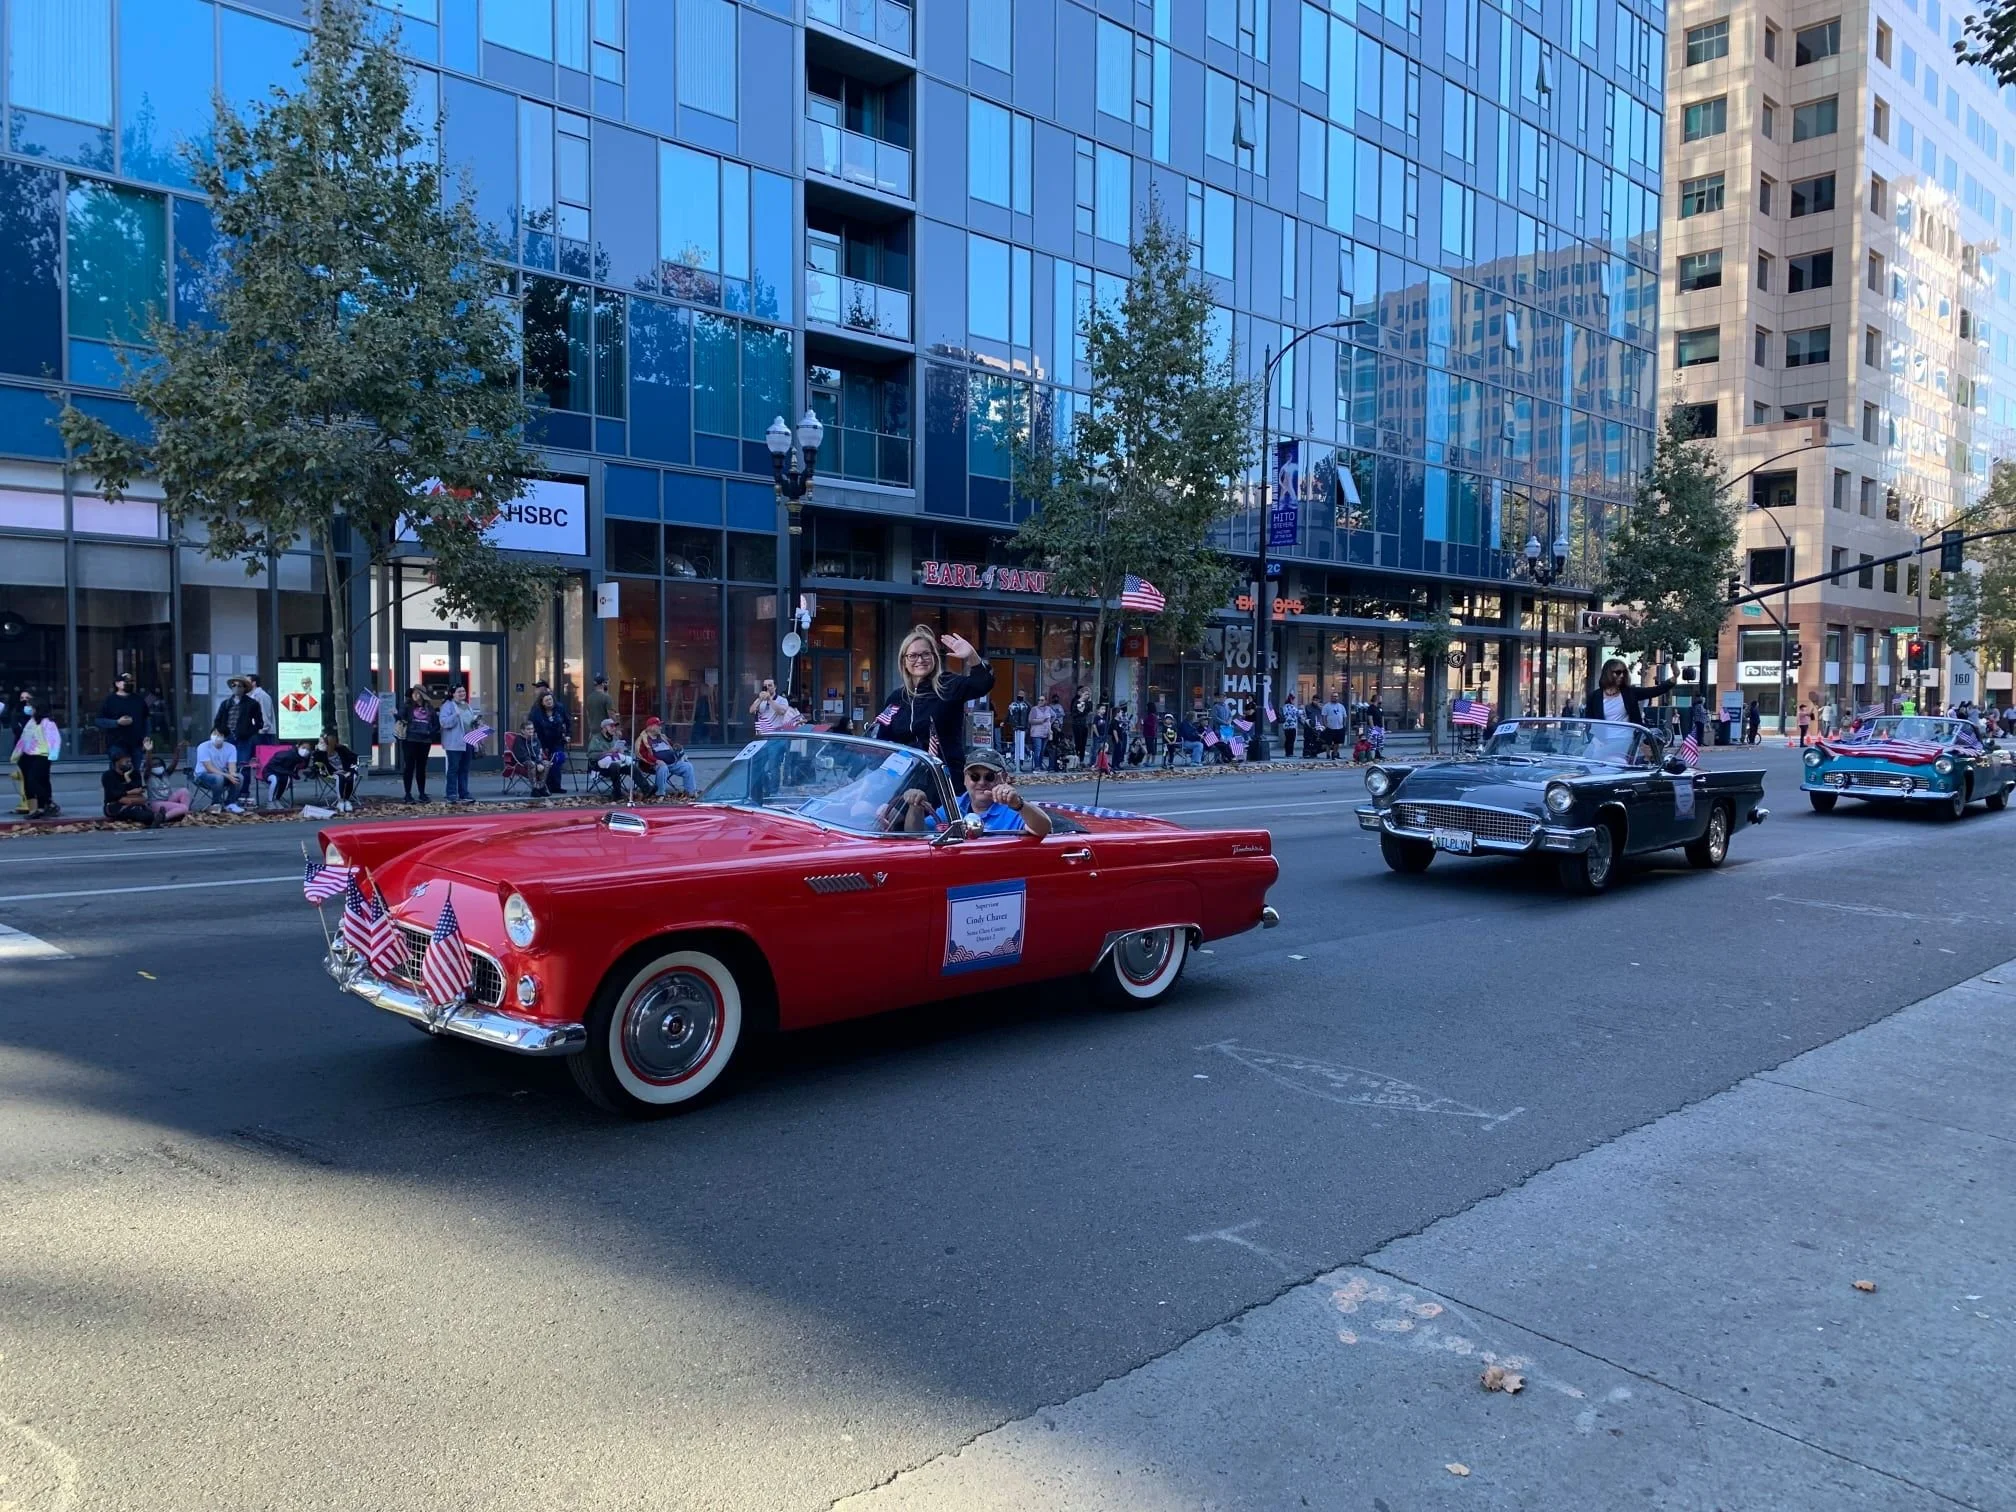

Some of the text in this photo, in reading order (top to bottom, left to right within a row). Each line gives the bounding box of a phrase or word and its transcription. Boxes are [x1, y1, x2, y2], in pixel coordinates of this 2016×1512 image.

[508, 504, 568, 527] HSBC
[1273, 511, 1295, 522] HITO
[922, 560, 983, 589] EARL
[1267, 563, 1281, 574] 2C
[1236, 594, 1304, 615] BIOPS
[1225, 650, 1278, 668] YOR
[1954, 673, 1970, 684] 160
[966, 914, 984, 925] Cindy
